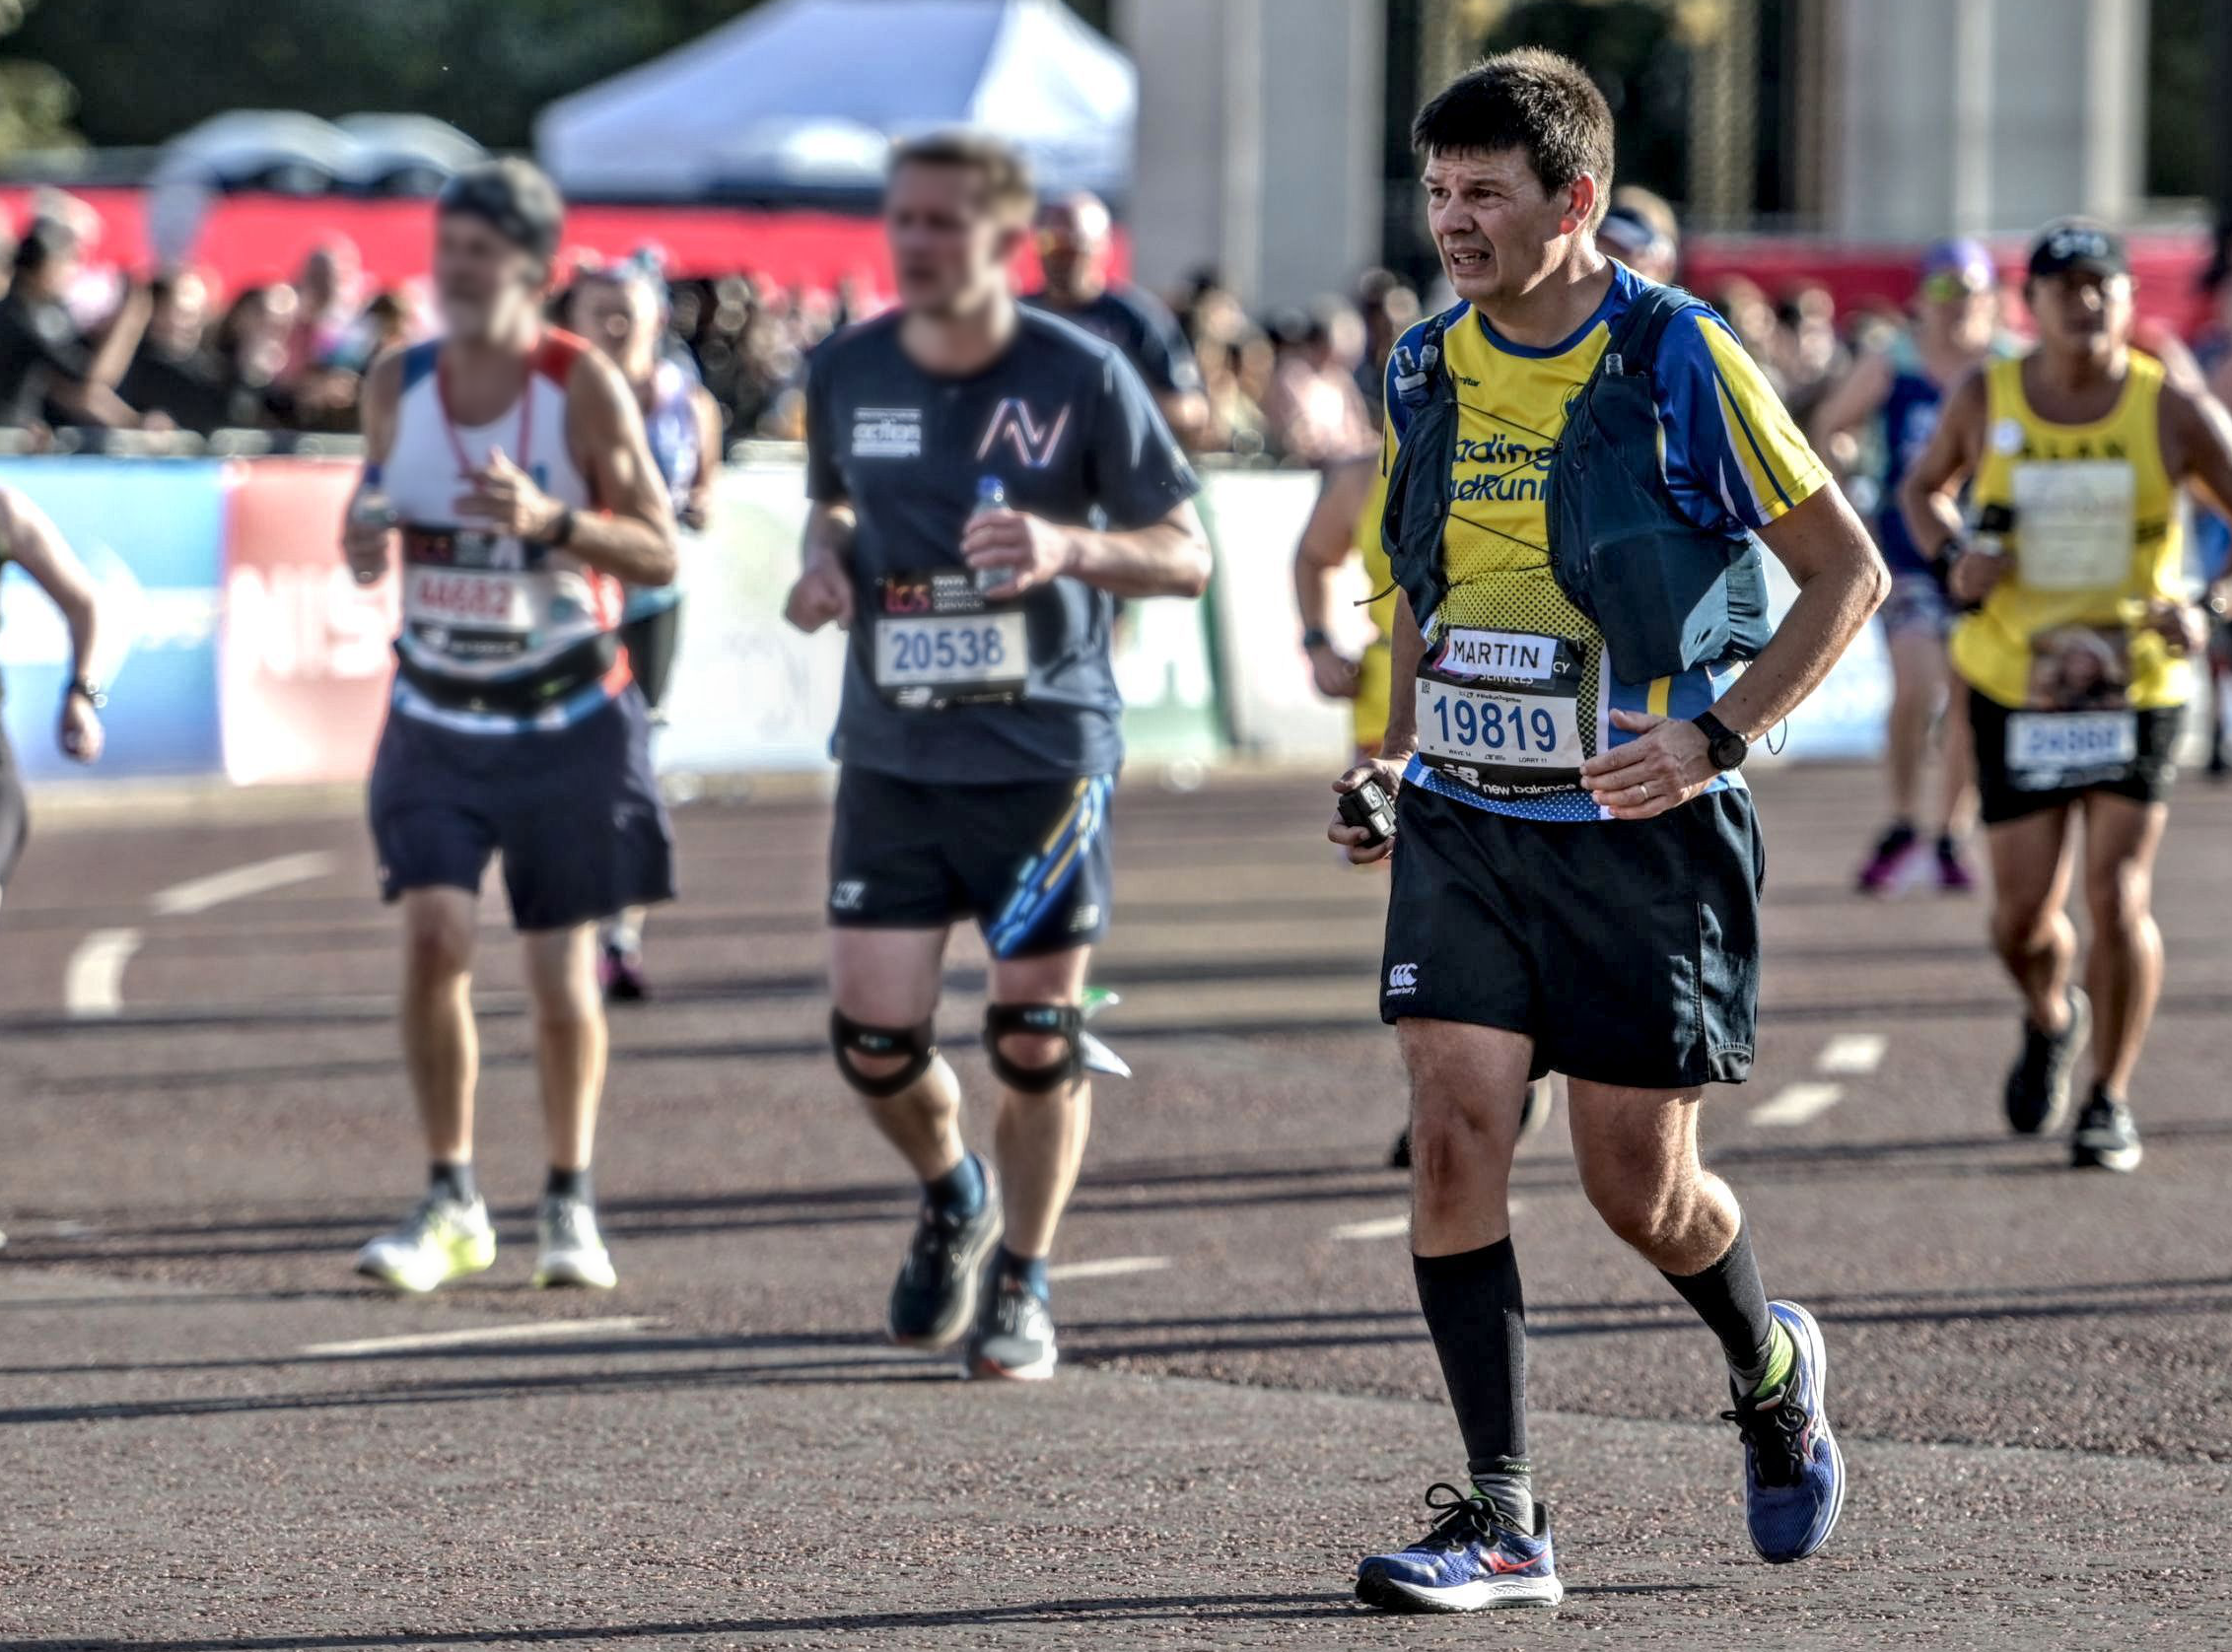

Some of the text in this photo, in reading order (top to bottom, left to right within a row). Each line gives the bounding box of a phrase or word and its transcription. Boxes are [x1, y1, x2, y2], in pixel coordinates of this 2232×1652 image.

[890, 625, 1005, 671] 20538
[1452, 640, 1541, 669] MARTIN
[1432, 695, 1557, 753] 19819
[1482, 783, 1576, 796] new balance
